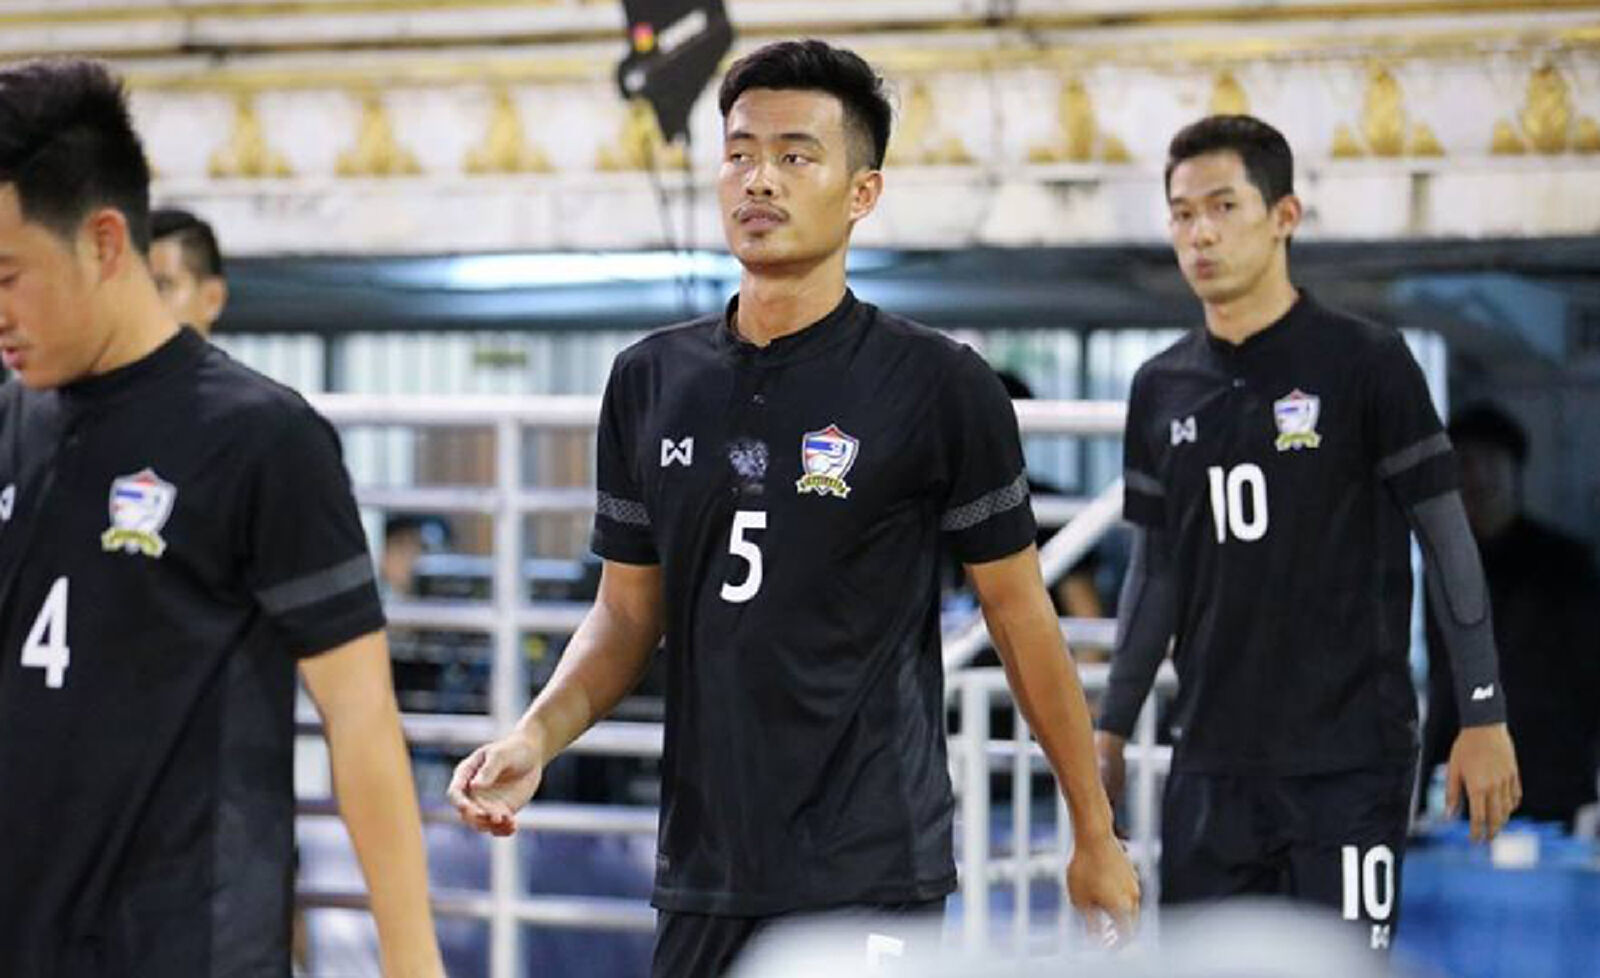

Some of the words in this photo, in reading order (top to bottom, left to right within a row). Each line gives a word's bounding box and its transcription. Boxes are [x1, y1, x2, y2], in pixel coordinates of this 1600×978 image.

[1207, 462, 1269, 544] 10
[720, 510, 767, 604] 5
[20, 575, 70, 689] 4
[1341, 844, 1395, 920] 10
